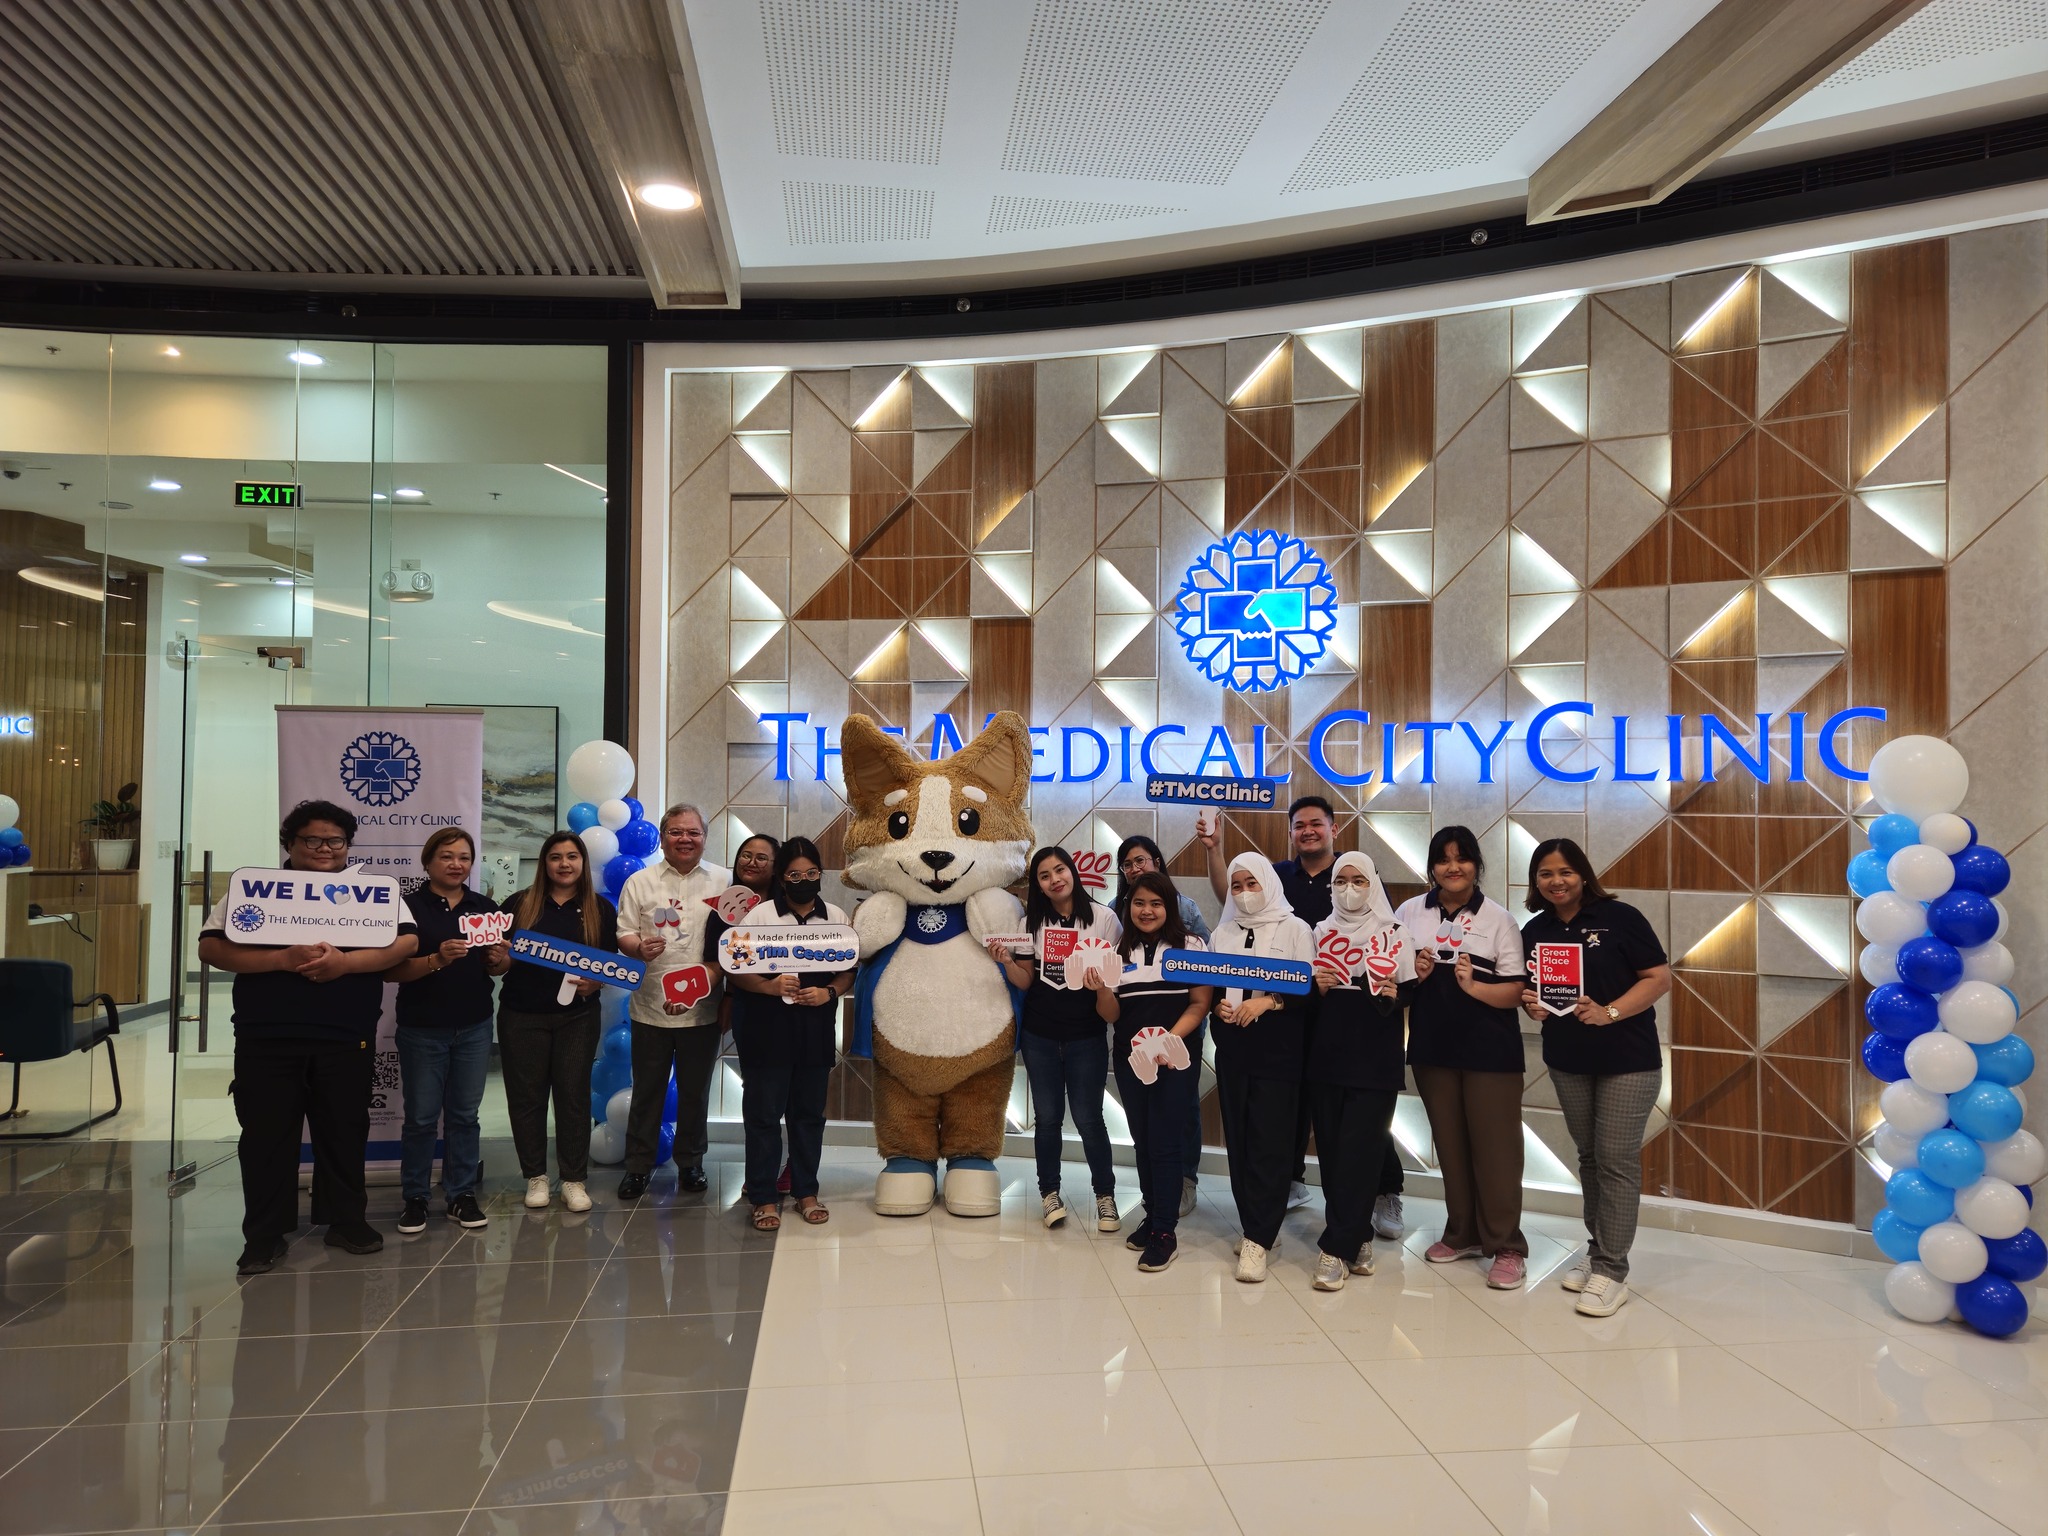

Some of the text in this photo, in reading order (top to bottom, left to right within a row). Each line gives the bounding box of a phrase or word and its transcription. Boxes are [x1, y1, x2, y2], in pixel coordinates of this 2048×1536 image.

[242, 486, 294, 504] EXIT
[1309, 709, 1515, 787] CITY
[1525, 701, 1887, 785] CLINIC
[1149, 780, 1272, 803] #TMCClinic
[388, 813, 418, 826] CITY
[420, 813, 462, 826] CLINIC
[393, 857, 411, 865] on:
[1072, 851, 1111, 873] 100
[241, 879, 294, 900] WE
[268, 914, 394, 928] THE MEDICAL CITY CLINIC
[461, 913, 511, 931] I My
[465, 928, 501, 946] Job!
[757, 932, 843, 941] Made friends with
[1046, 931, 1070, 939] Great
[756, 944, 856, 962] Tim CeeCee
[1319, 929, 1363, 965] 100
[1542, 948, 1570, 956] Great
[513, 937, 641, 985] #TimCeeCee
[1542, 956, 1570, 965] Place
[1542, 965, 1553, 973] To
[1165, 959, 1308, 983] @themedicalcityclinic
[691, 978, 697, 988] 1
[1544, 986, 1577, 995] Certified
